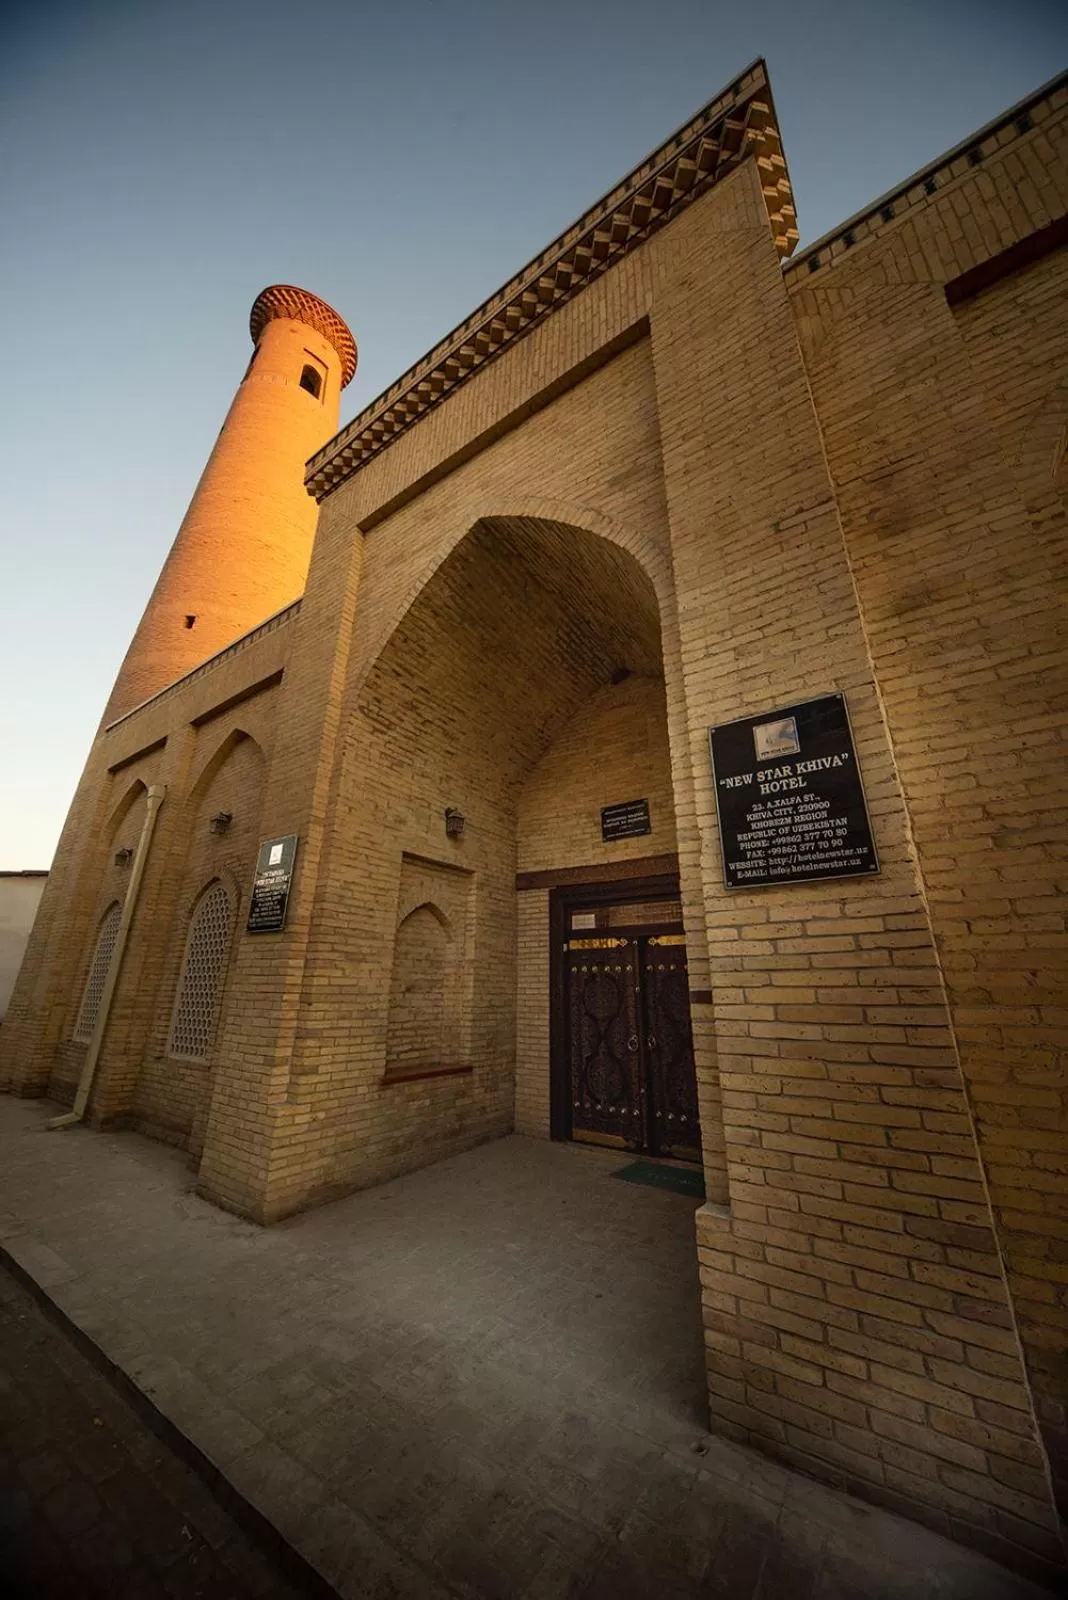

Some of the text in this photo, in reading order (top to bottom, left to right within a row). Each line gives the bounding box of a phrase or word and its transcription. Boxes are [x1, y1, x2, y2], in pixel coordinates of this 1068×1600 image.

[757, 765, 792, 782] STAR
[760, 776, 807, 795] HOTEL
[746, 801, 830, 821] KHIVA CITY, 220900
[751, 810, 828, 830] KHOREZM REGION
[737, 817, 848, 841] REPUBLIC OF UZBEKISTAN
[740, 840, 770, 850] PHONE:
[803, 831, 821, 840] 377
[822, 830, 834, 838] 70
[746, 839, 843, 859] FAX: +99862 377 70 90
[728, 860, 768, 870] WEBSITE:
[737, 869, 768, 879] E-MAIL:
